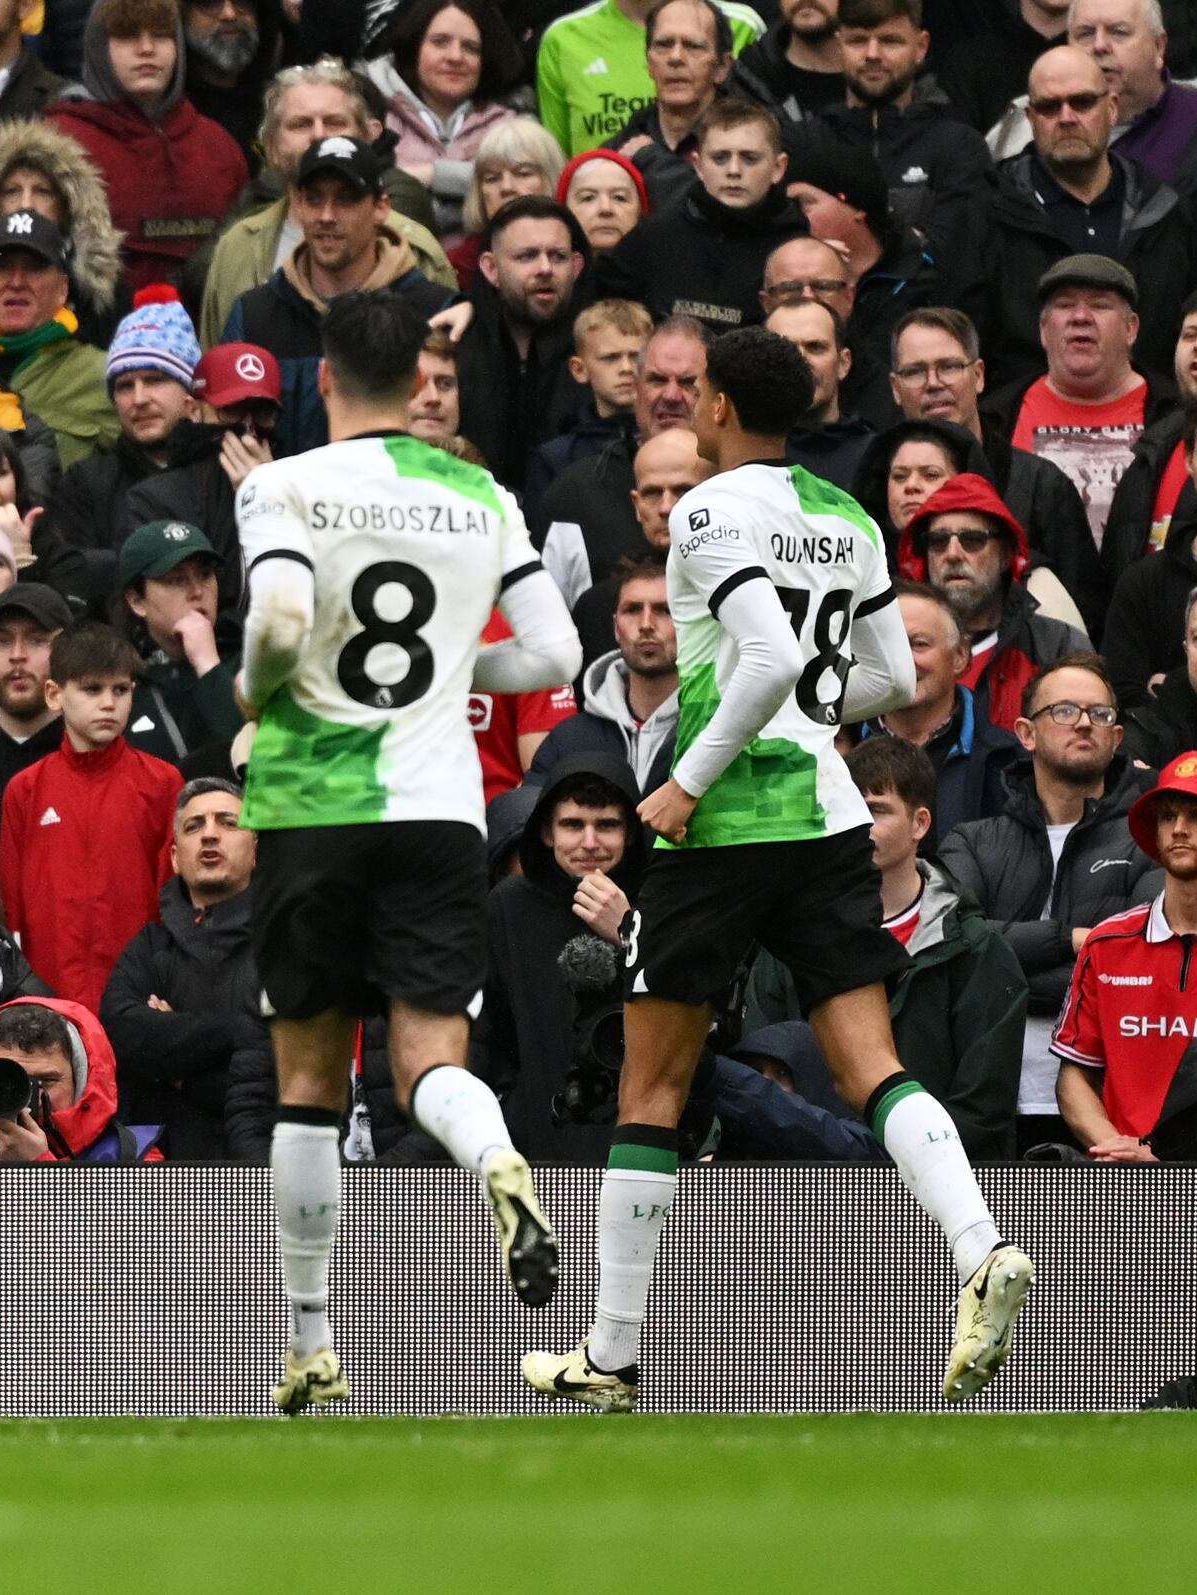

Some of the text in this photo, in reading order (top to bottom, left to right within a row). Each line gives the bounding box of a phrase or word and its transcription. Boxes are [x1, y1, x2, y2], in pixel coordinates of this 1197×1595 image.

[312, 501, 490, 535] SZOBOSZLAI
[679, 525, 740, 559] Expedia
[337, 561, 436, 709] 8
